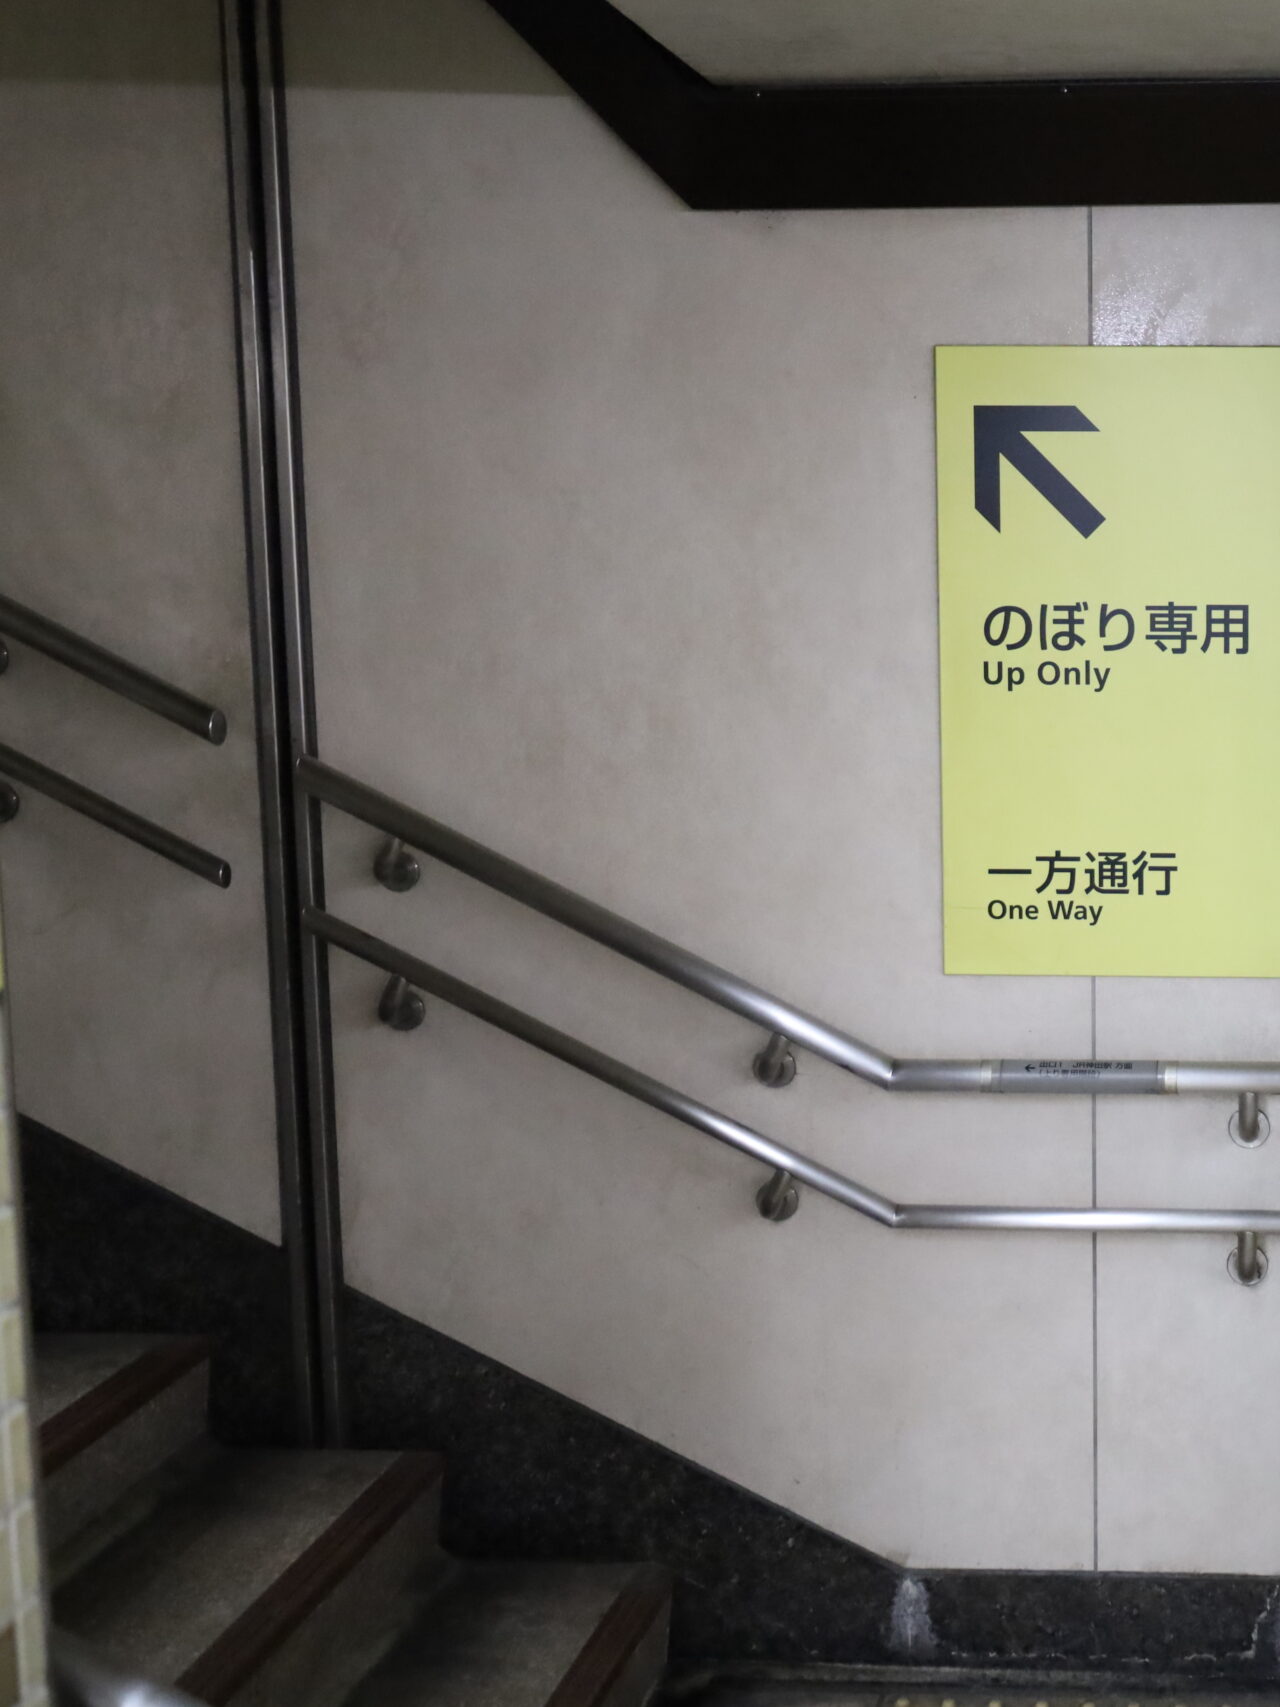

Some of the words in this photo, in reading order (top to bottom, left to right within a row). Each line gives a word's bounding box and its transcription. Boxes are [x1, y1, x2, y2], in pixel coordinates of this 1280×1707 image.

[984, 601, 1249, 655] のぼり専用
[983, 661, 1025, 691] Up
[1037, 660, 1111, 692] Only
[988, 850, 1177, 896] 一方通行
[987, 900, 1039, 920] One
[1047, 900, 1103, 925] Way
